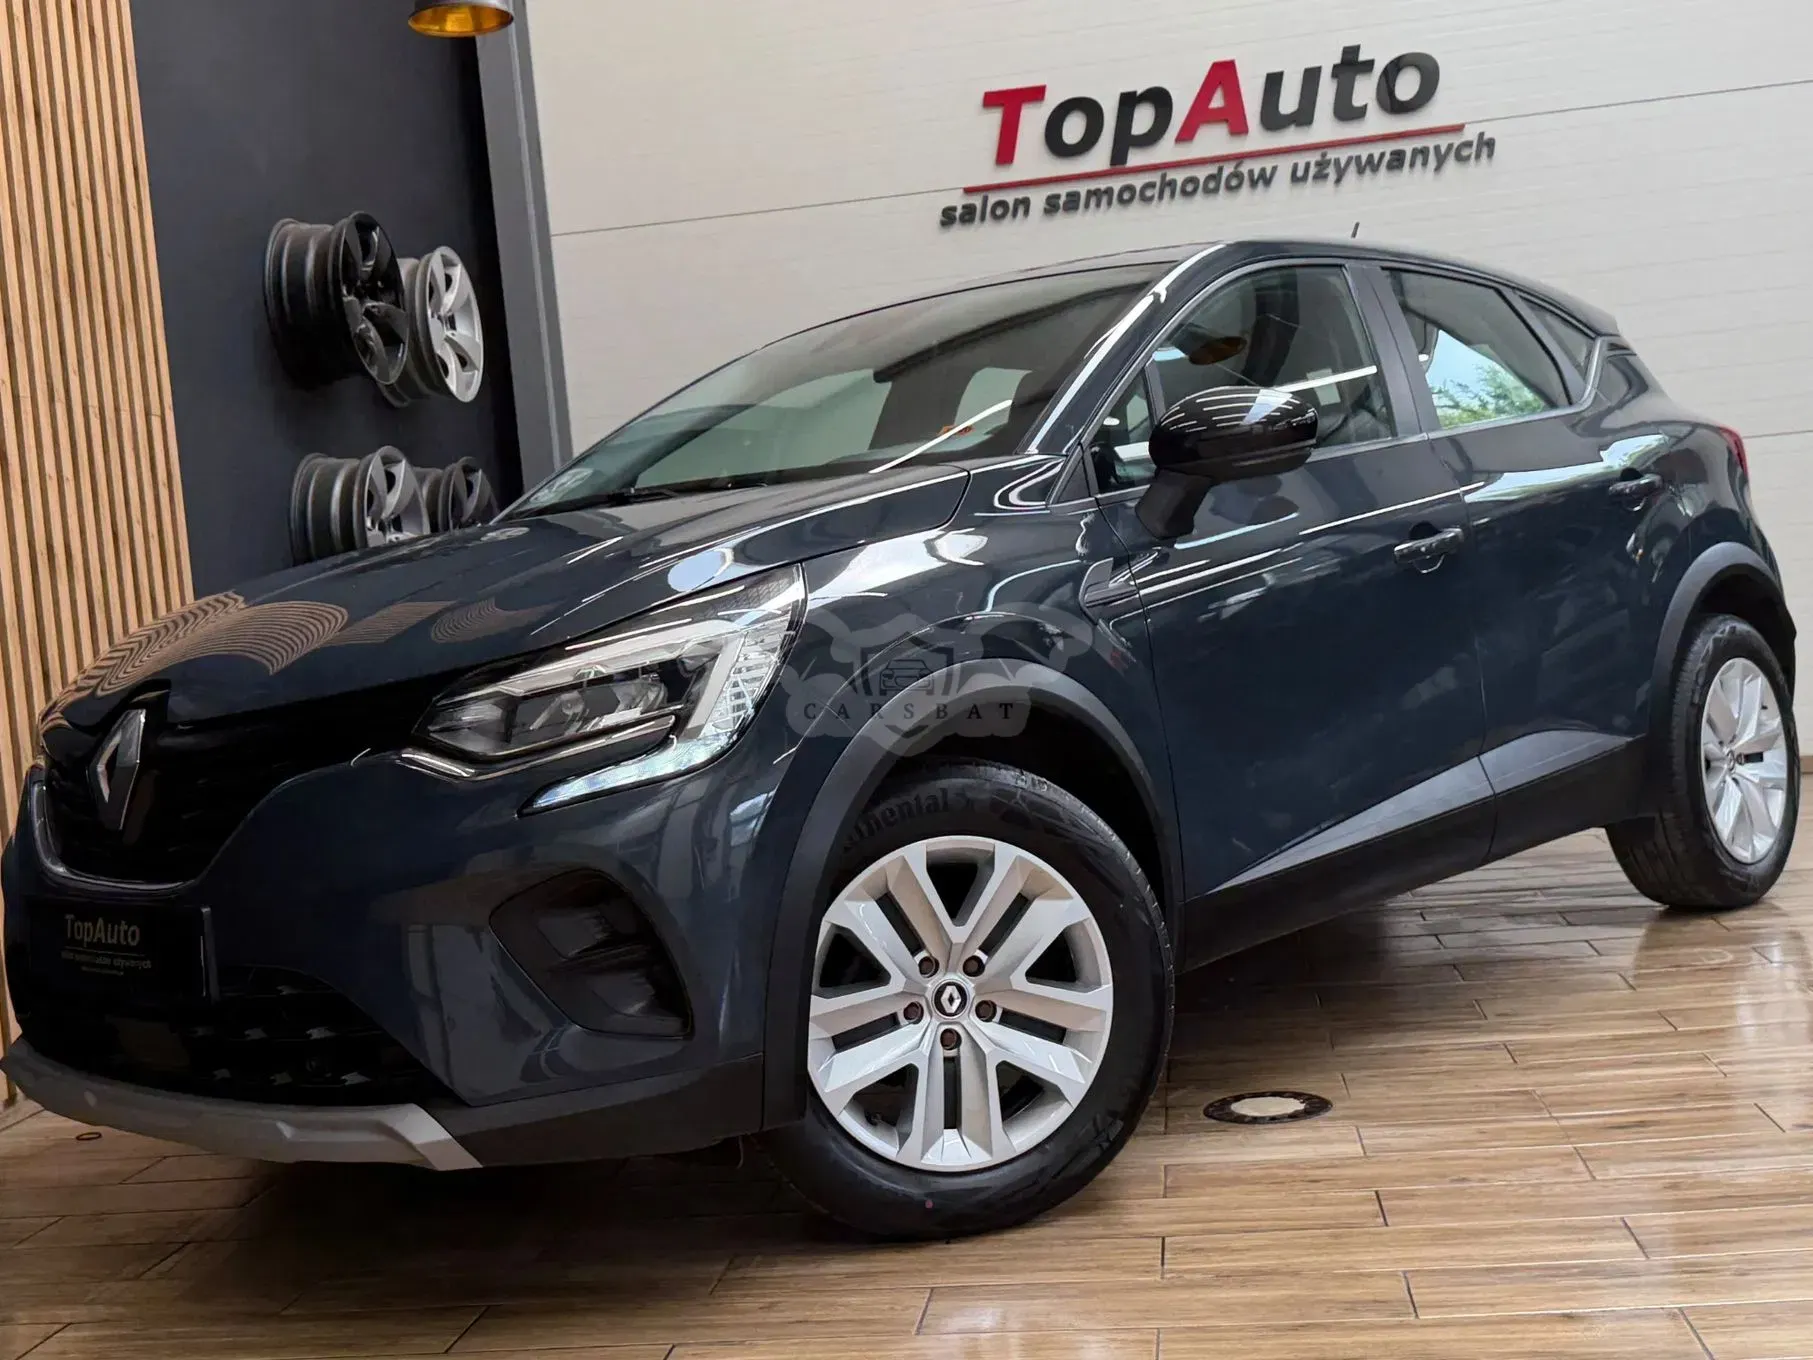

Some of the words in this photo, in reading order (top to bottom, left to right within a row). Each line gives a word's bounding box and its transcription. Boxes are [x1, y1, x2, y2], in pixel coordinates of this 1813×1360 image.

[982, 45, 1440, 167] TopAuto
[940, 192, 1032, 227] salon
[1043, 161, 1279, 216] samochodów
[1290, 132, 1497, 182] używanych
[64, 913, 141, 947] TopAuto
